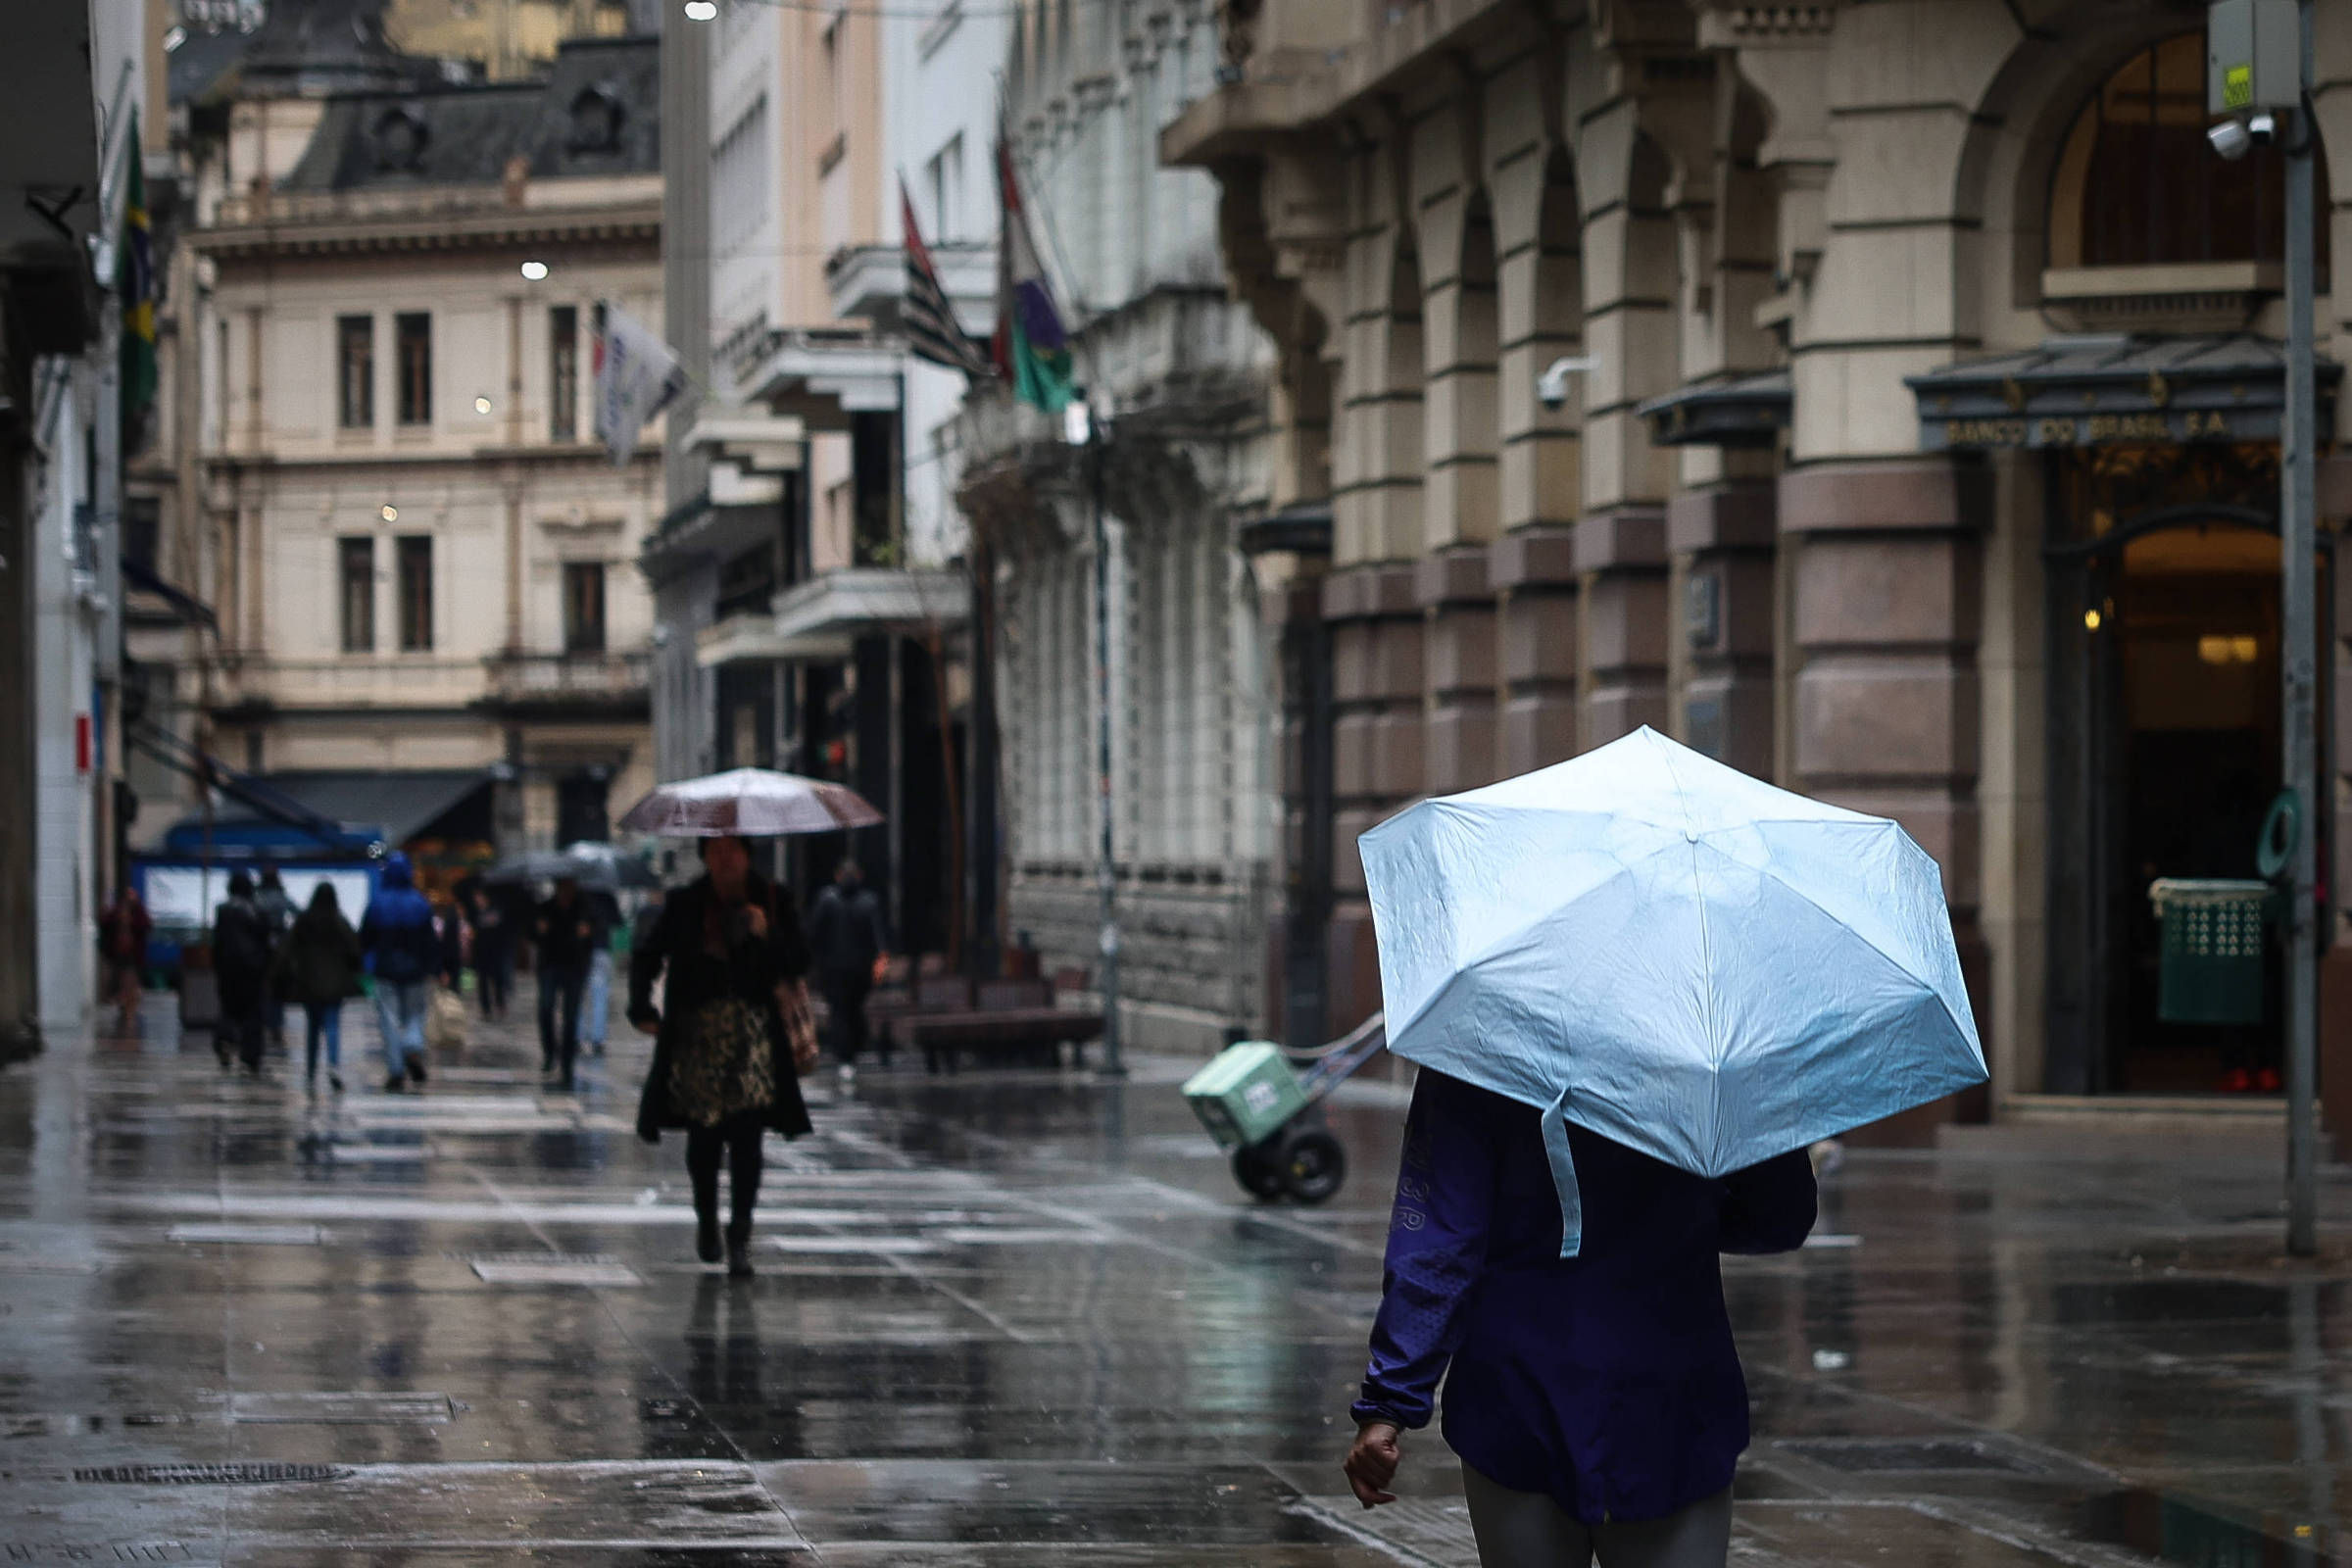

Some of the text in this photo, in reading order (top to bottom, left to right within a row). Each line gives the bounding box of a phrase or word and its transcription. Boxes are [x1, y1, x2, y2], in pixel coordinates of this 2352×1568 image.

[1946, 418, 2025, 444] BANCO
[2039, 416, 2076, 442] DO
[2089, 414, 2170, 439] BRASIL
